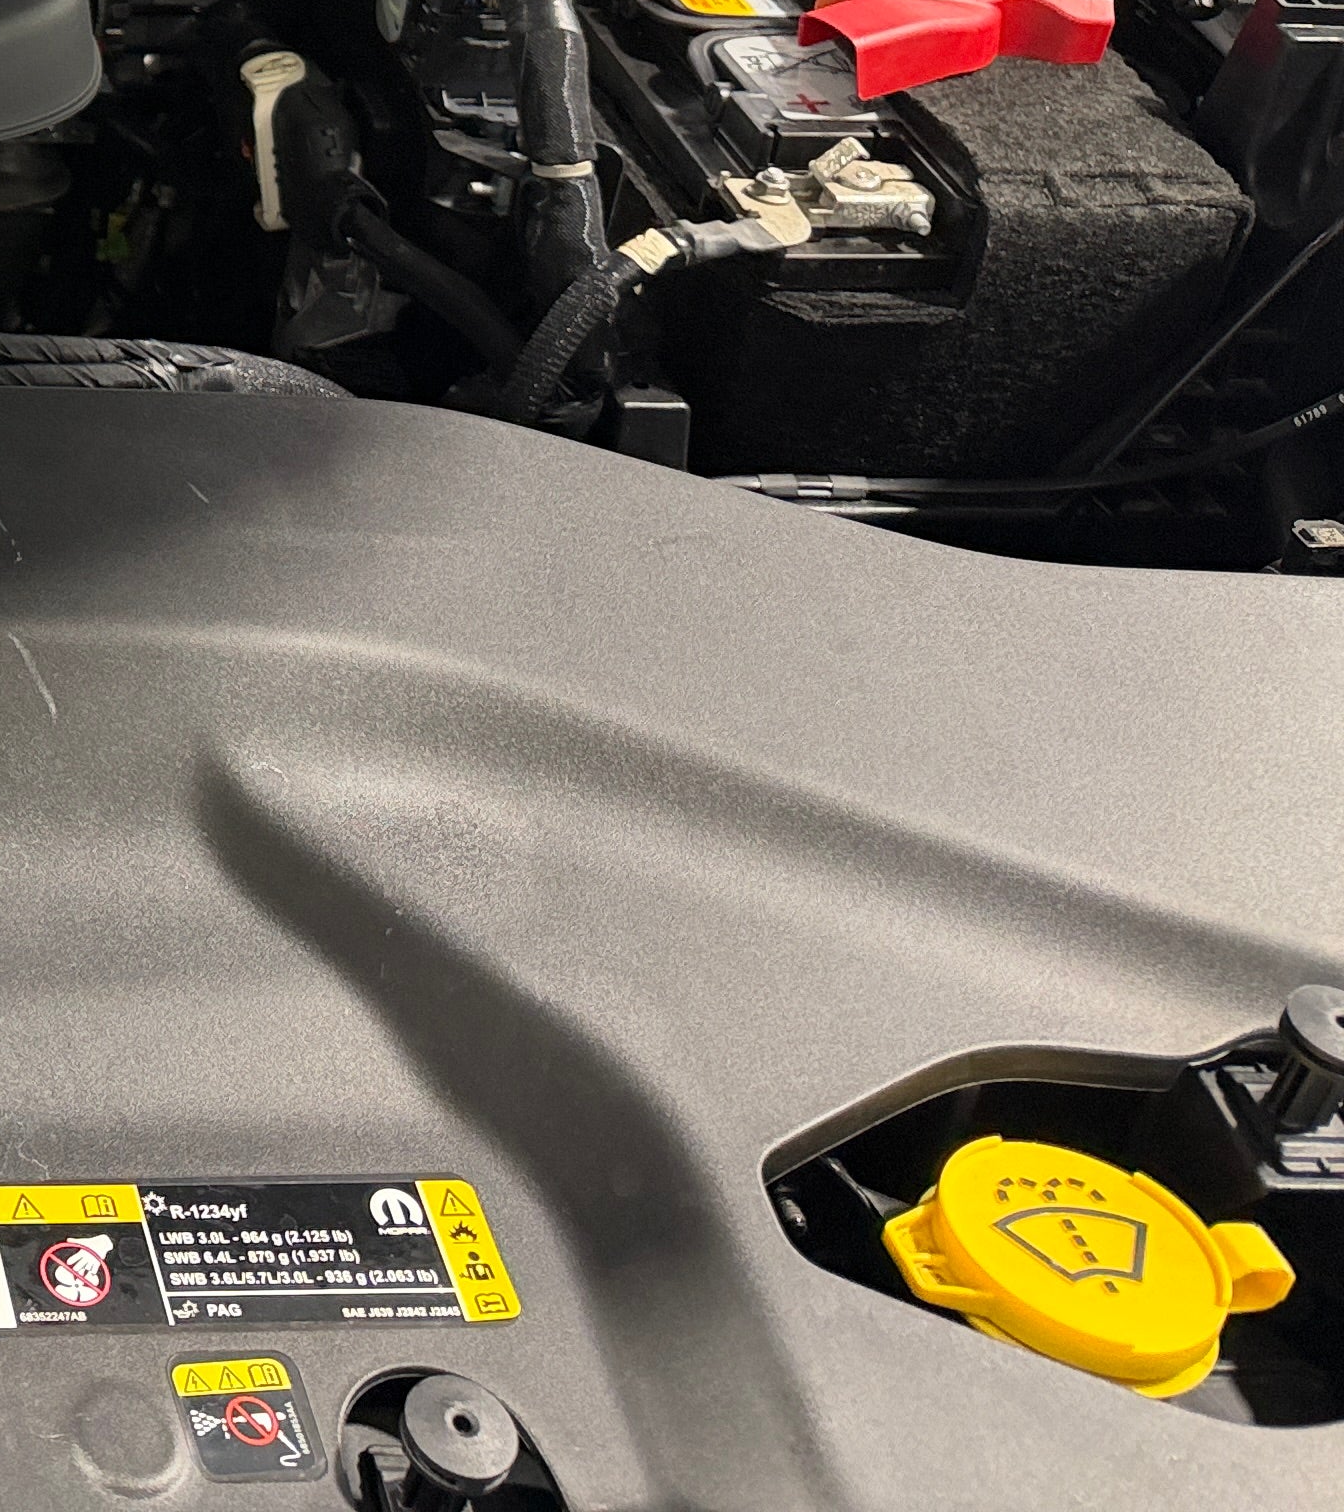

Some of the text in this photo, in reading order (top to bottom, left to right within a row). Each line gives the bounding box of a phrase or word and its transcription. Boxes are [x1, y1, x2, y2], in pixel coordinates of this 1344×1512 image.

[169, 1204, 248, 1222] R-1234yf
[159, 1231, 195, 1245] LWB
[196, 1231, 231, 1245] 3.0L
[240, 1230, 269, 1244] 964
[271, 1233, 284, 1246] g
[284, 1230, 331, 1247] (2.125
[331, 1229, 354, 1246] lb)
[163, 1251, 201, 1265] SWB
[203, 1250, 237, 1264] 6.4L
[247, 1250, 276, 1264] 879
[278, 1252, 290, 1266] g
[291, 1249, 335, 1266] (1.937
[338, 1249, 361, 1265] lb)
[169, 1272, 208, 1286] SWB
[324, 1270, 353, 1284] 936
[355, 1272, 368, 1286] g
[368, 1269, 415, 1286] (2.063
[416, 1268, 439, 1285] lb)
[206, 1303, 243, 1318] PAG
[341, 1307, 367, 1318] SAE
